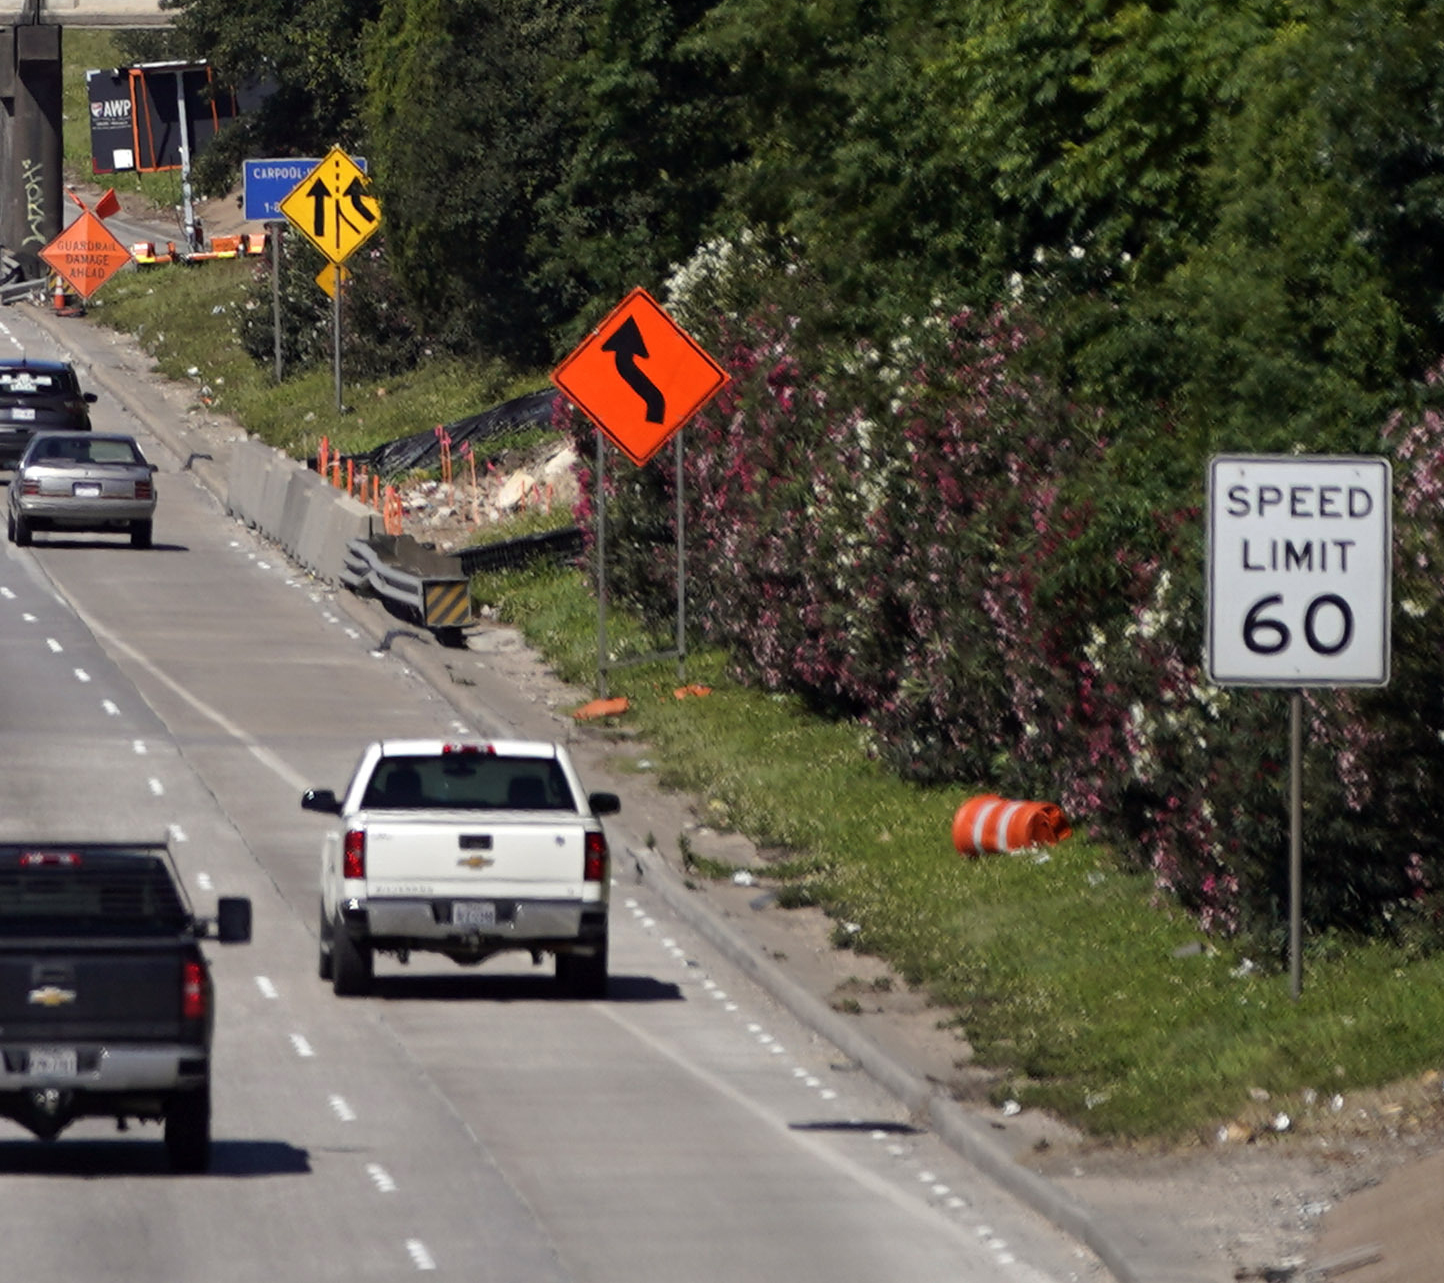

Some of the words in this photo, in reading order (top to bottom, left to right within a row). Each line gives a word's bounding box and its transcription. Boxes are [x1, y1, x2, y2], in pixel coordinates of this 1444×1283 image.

[103, 99, 132, 118] AWP
[57, 240, 117, 252] GUARDRAIL
[65, 254, 110, 266] DAMAGE
[69, 267, 106, 279] AHEAD
[1226, 484, 1374, 519] SPEED
[1242, 538, 1356, 573] LIMIT
[1242, 592, 1355, 658] 60
